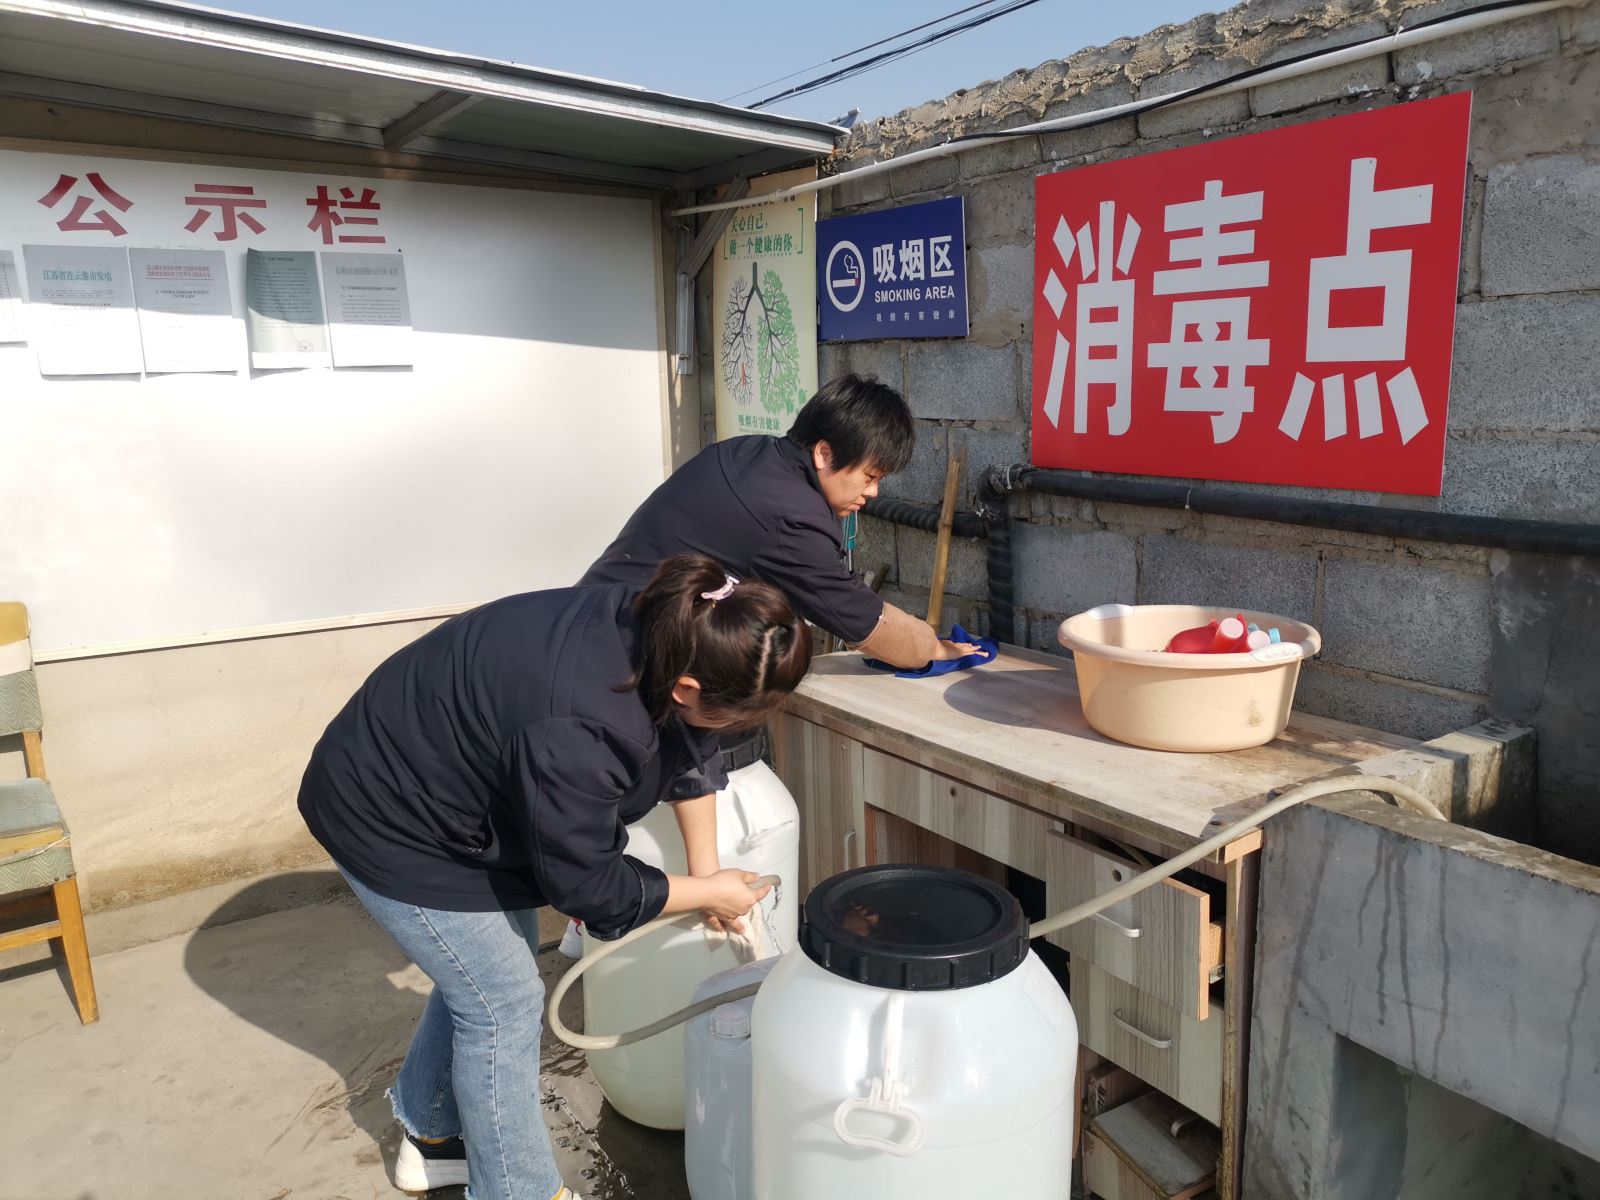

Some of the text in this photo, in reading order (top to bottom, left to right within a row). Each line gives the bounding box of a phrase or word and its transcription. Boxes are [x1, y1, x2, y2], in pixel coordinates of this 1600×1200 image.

[37, 172, 386, 245] 公示栏
[872, 235, 955, 284] 吸烟区
[874, 285, 956, 303] SMOKING AREA
[875, 309, 956, 322] 吸烟有害健康
[1041, 156, 1434, 446] 消毒点
